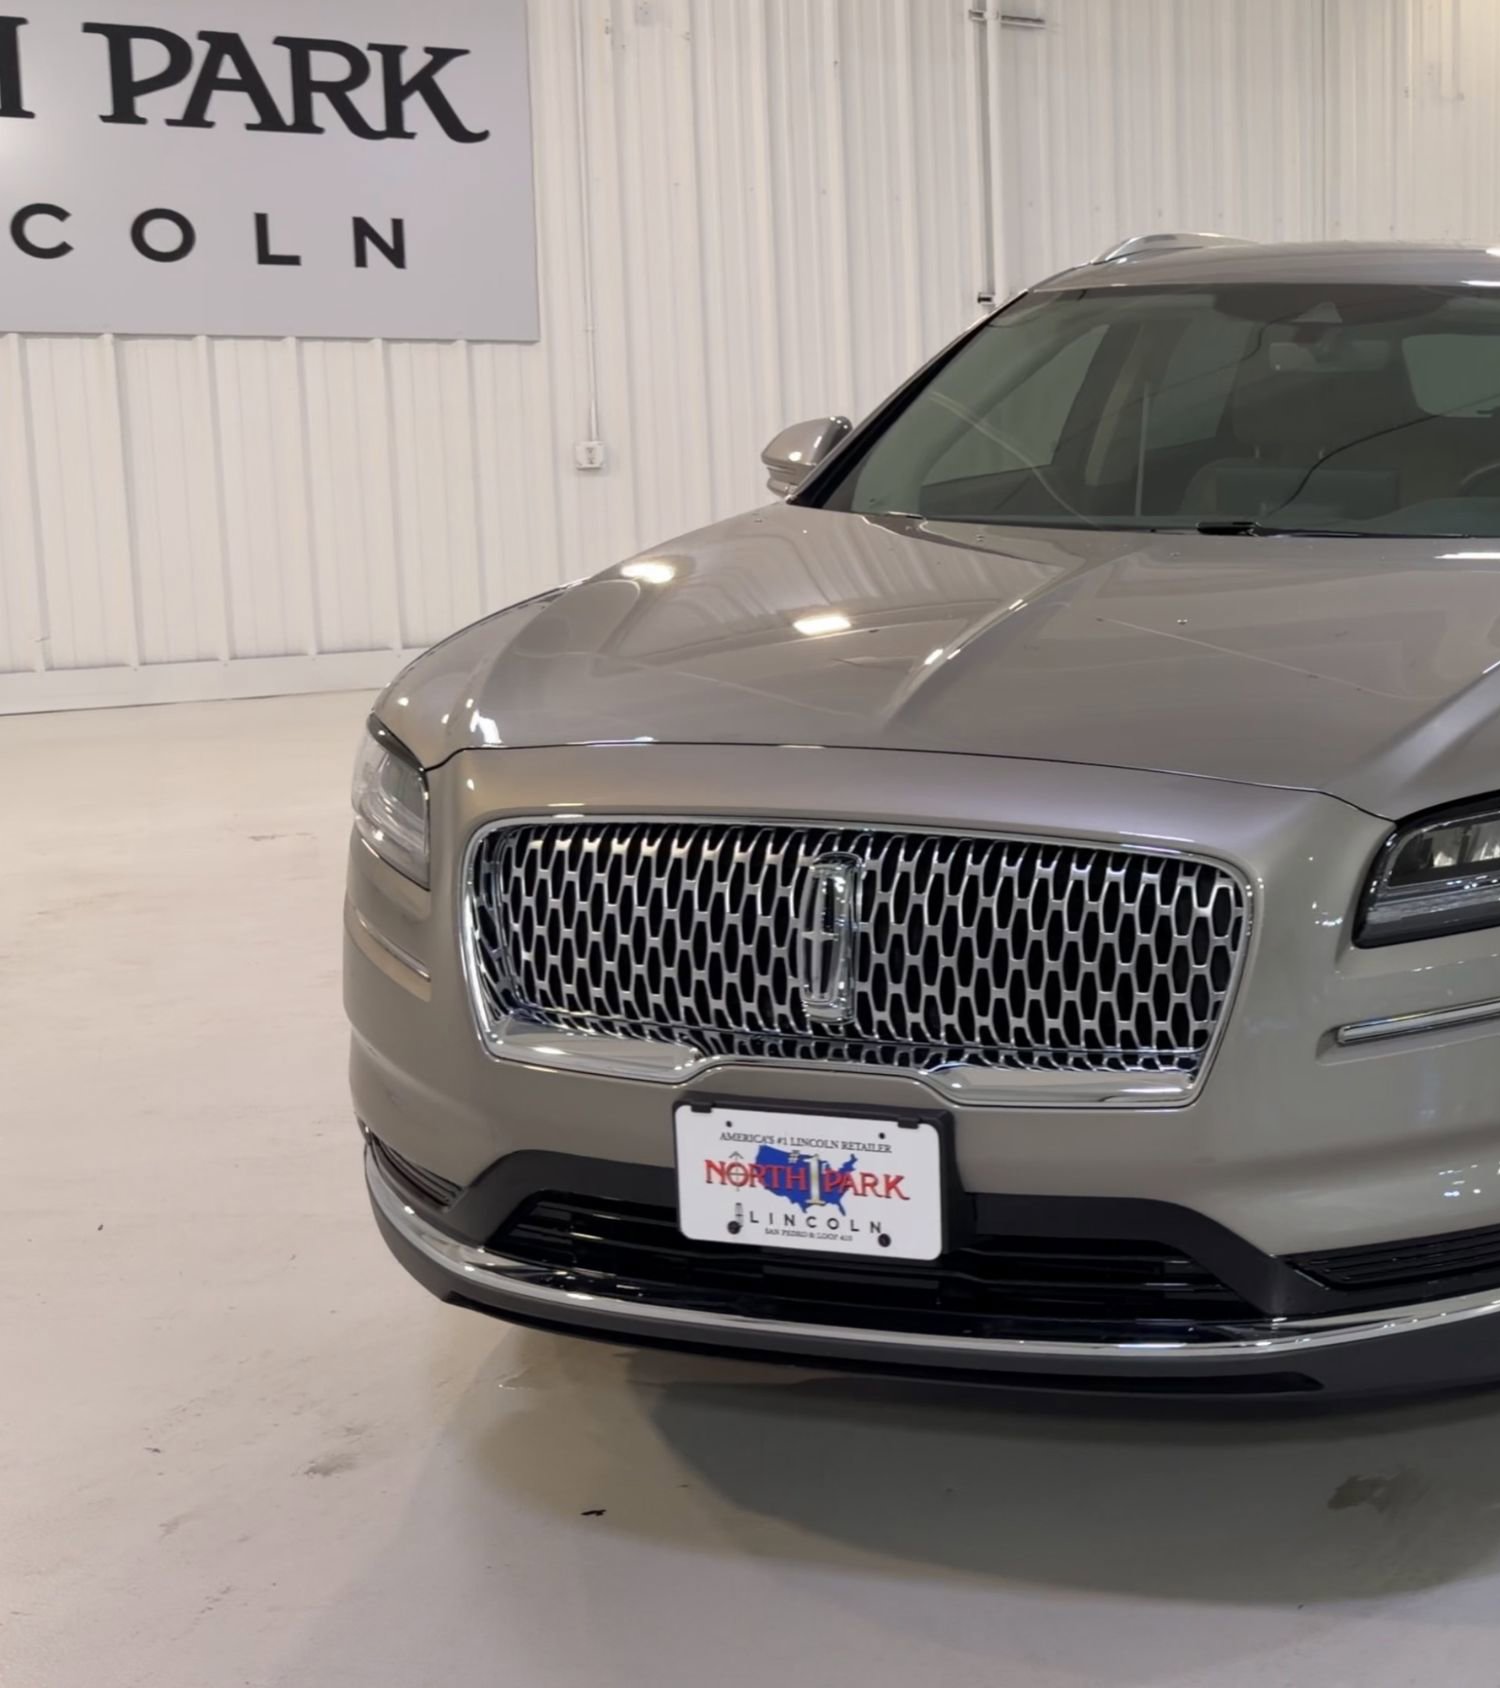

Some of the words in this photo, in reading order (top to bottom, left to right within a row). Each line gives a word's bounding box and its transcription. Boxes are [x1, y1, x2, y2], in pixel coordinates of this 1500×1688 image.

[82, 21, 490, 144] PARK
[719, 1131, 776, 1145] AMERICA'S
[790, 1137, 840, 1150] LINCOLN
[841, 1141, 893, 1153] RETAILER
[704, 1159, 808, 1191] NORTH
[823, 1167, 911, 1201] PARK
[749, 1210, 883, 1235] LINCOLN
